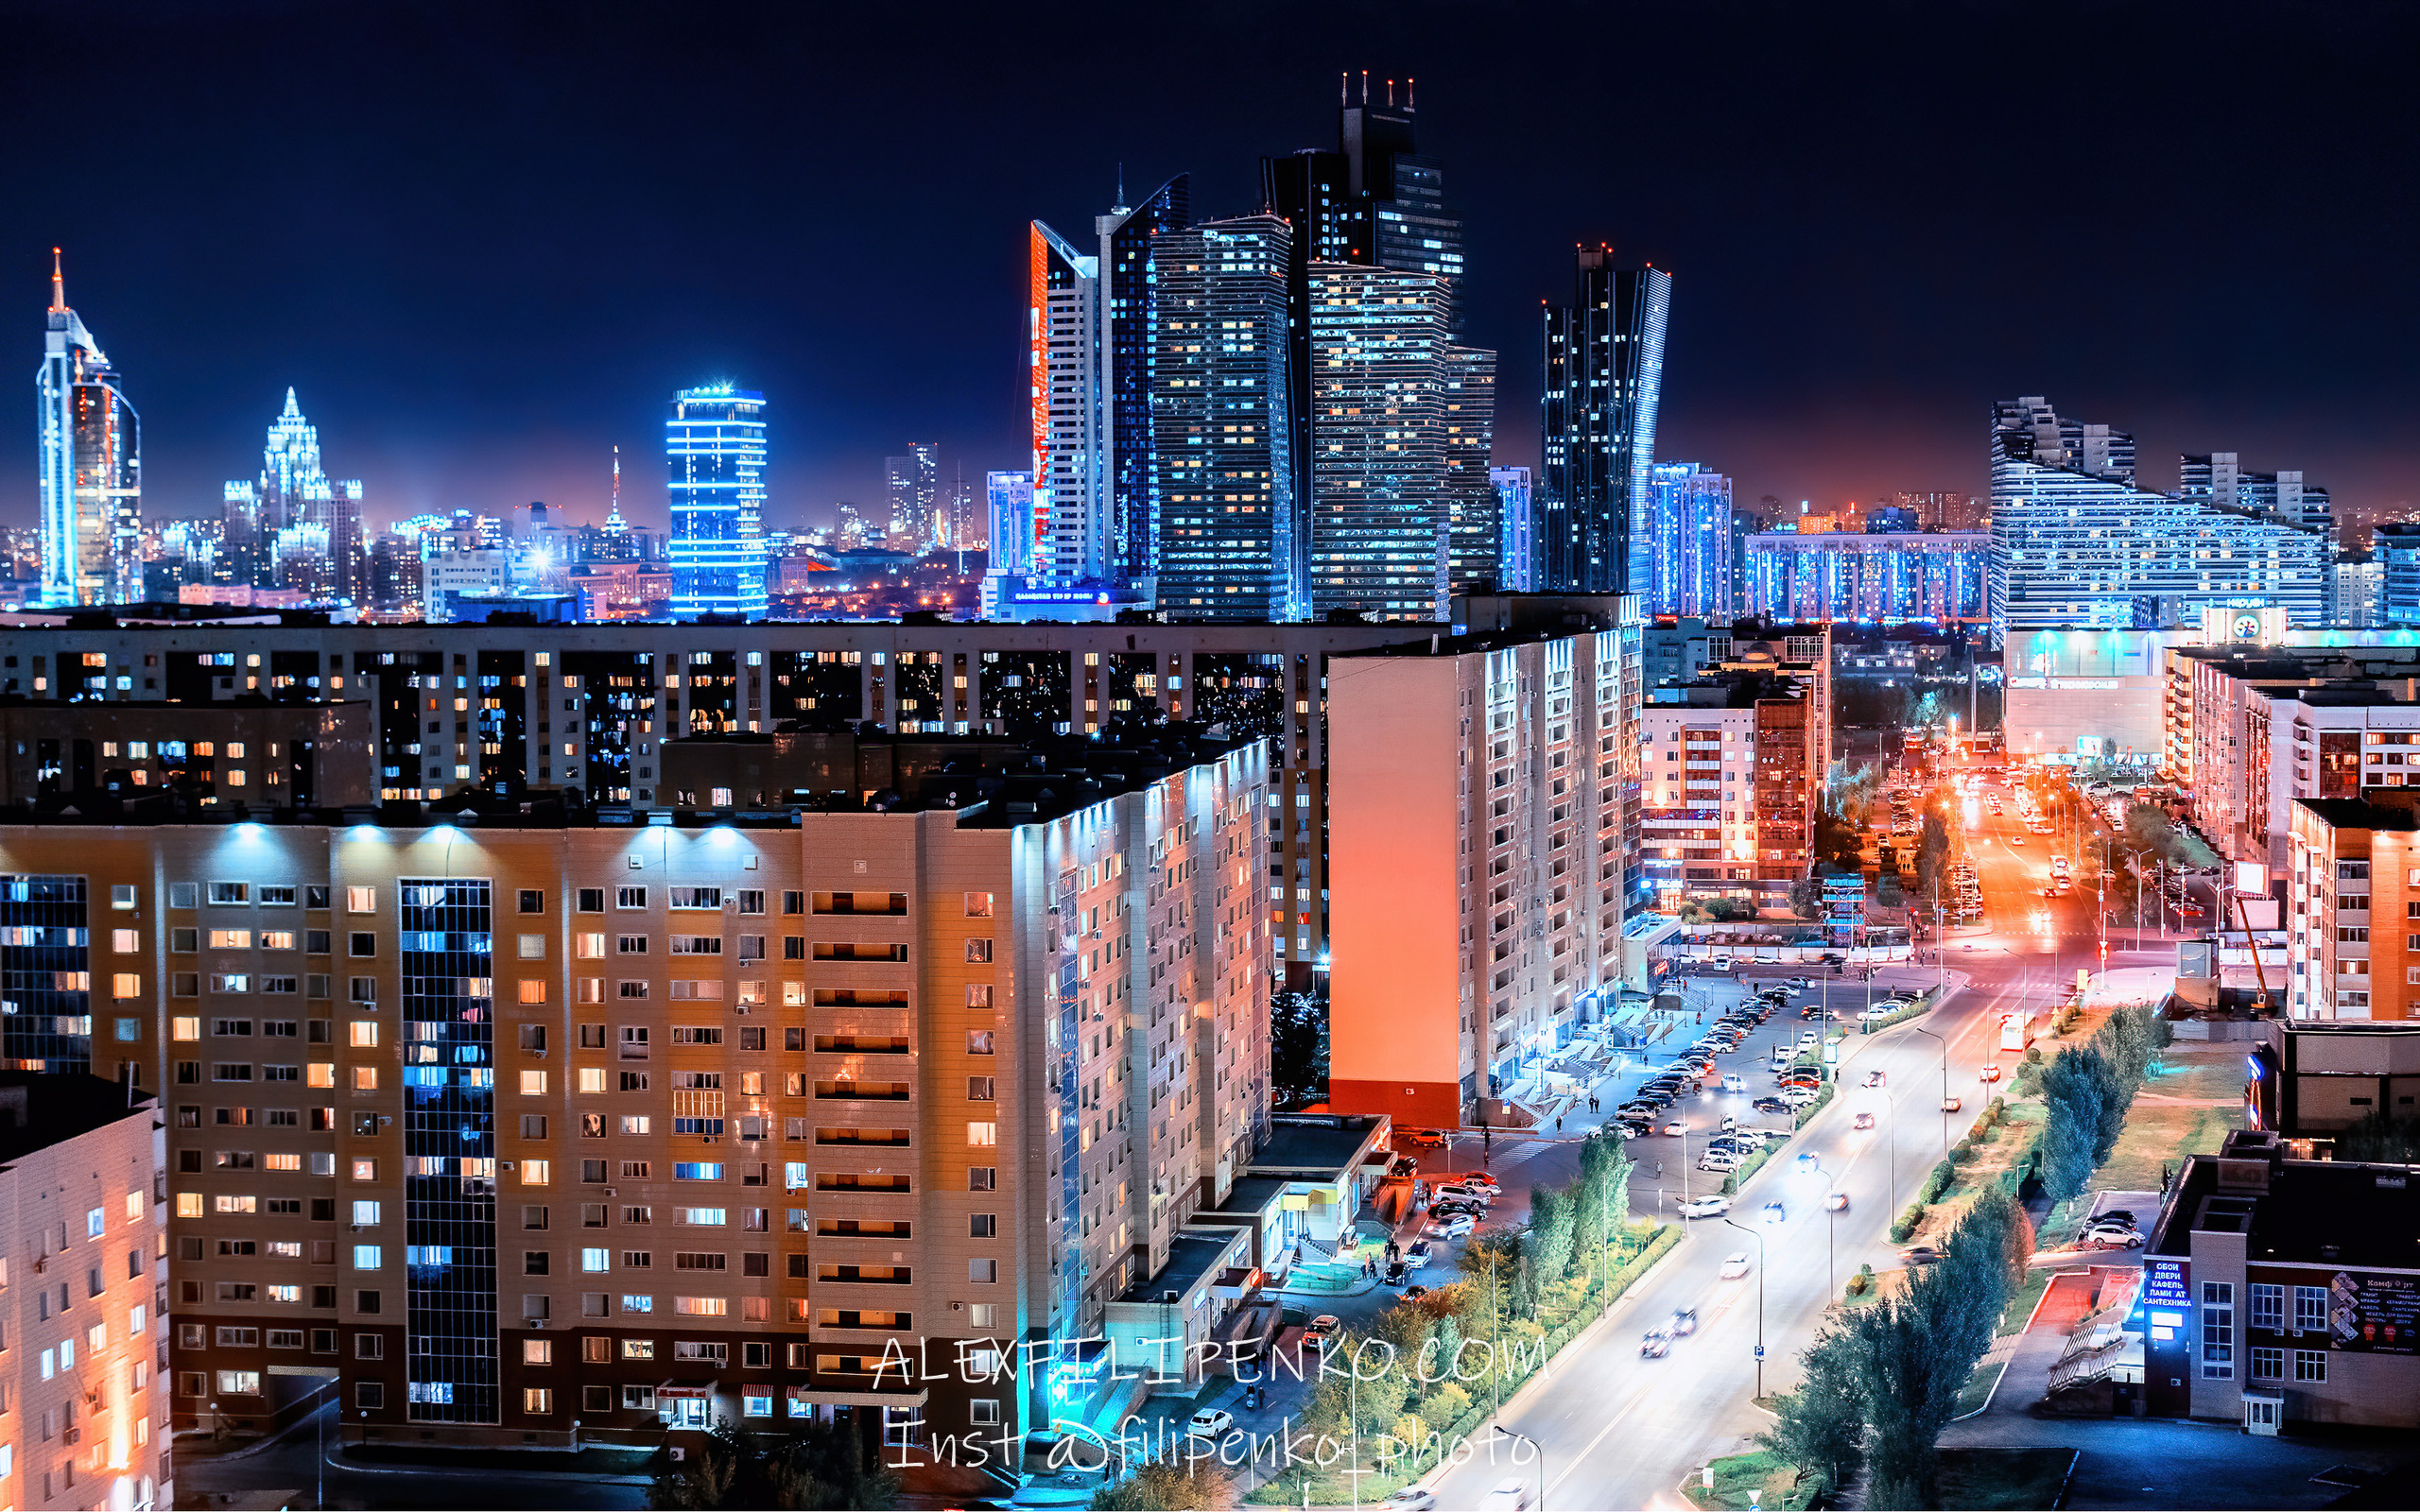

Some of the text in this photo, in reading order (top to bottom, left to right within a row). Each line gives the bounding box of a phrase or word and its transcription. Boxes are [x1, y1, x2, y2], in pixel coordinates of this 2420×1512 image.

[2156, 1263, 2179, 1271] ОБОИ
[2152, 1280, 2183, 1289] КАФЕЛЬ
[2143, 1297, 2192, 1307] САНТЕХНИКА
